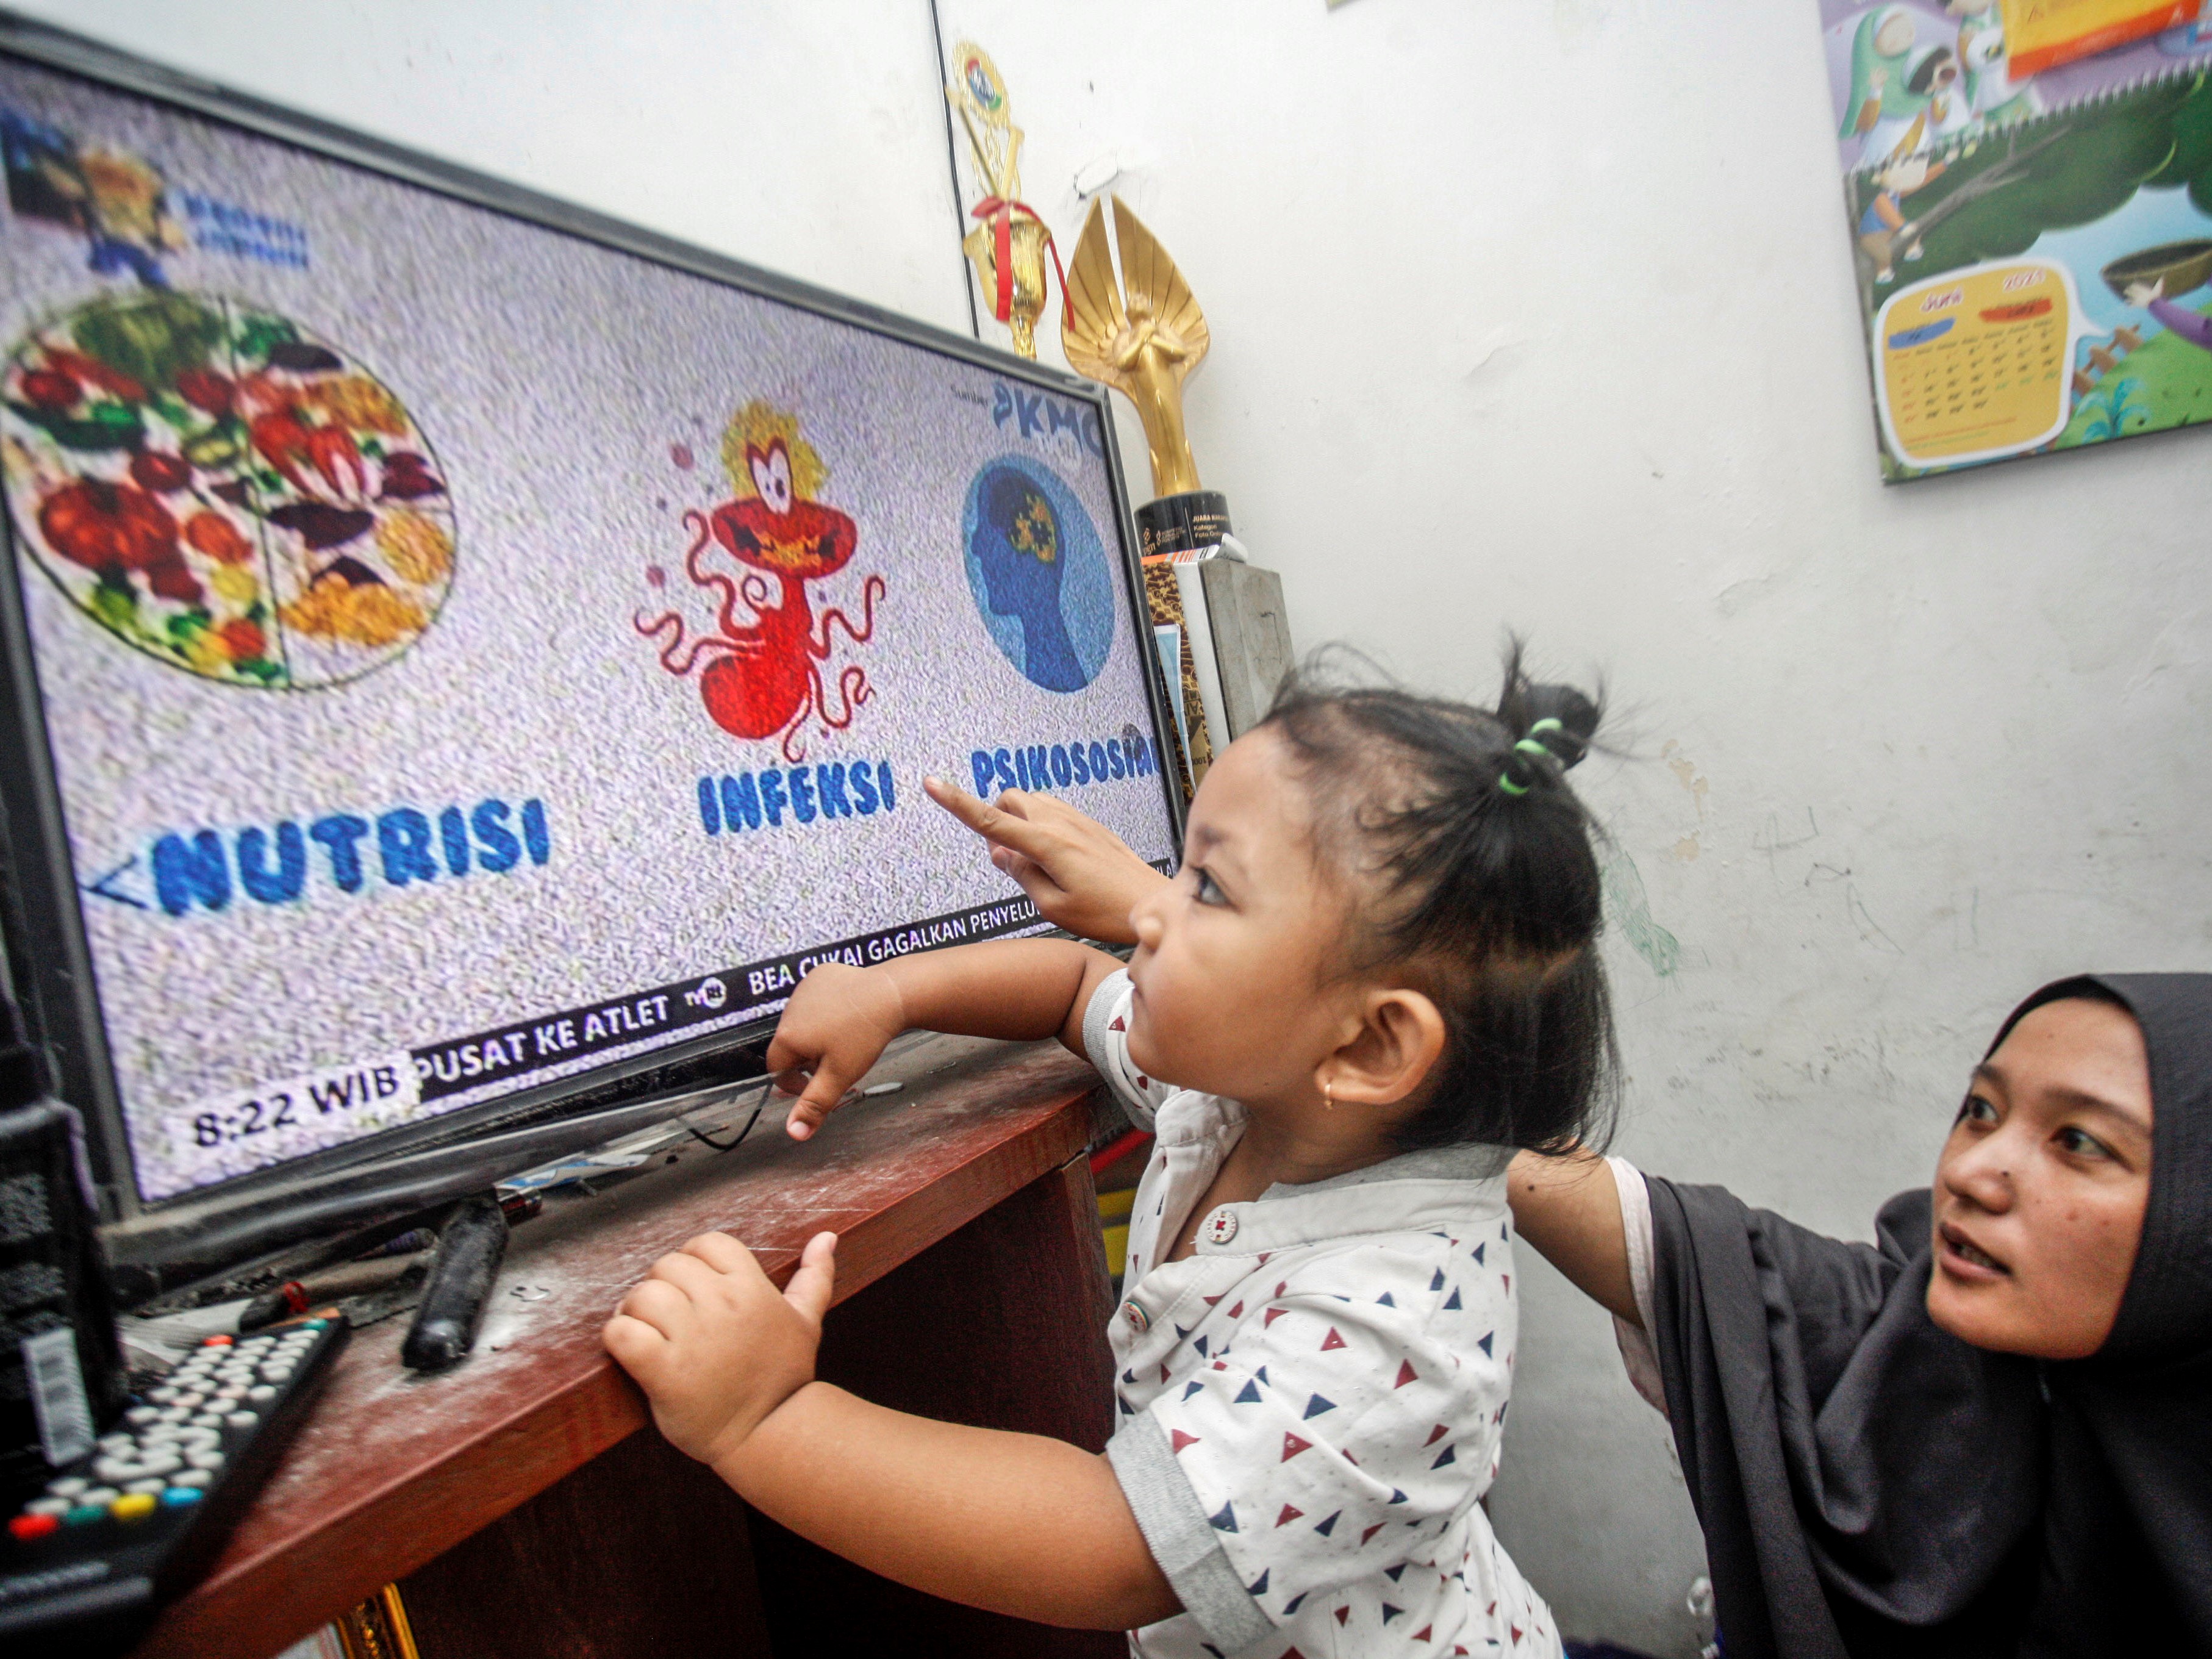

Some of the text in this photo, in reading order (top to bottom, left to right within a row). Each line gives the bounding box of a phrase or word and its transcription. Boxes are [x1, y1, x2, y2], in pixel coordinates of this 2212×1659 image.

[697, 760, 895, 836] INFEKSI
[152, 797, 551, 917] NUTRISI
[413, 1032, 527, 1082] PUSAT
[534, 1019, 578, 1055] KE
[585, 995, 670, 1042] ATLET
[748, 964, 795, 995] BEA
[868, 917, 967, 961] GAGALKAN
[970, 900, 1040, 934] PENYELU
[194, 1066, 399, 1147] 8:22 WIB
